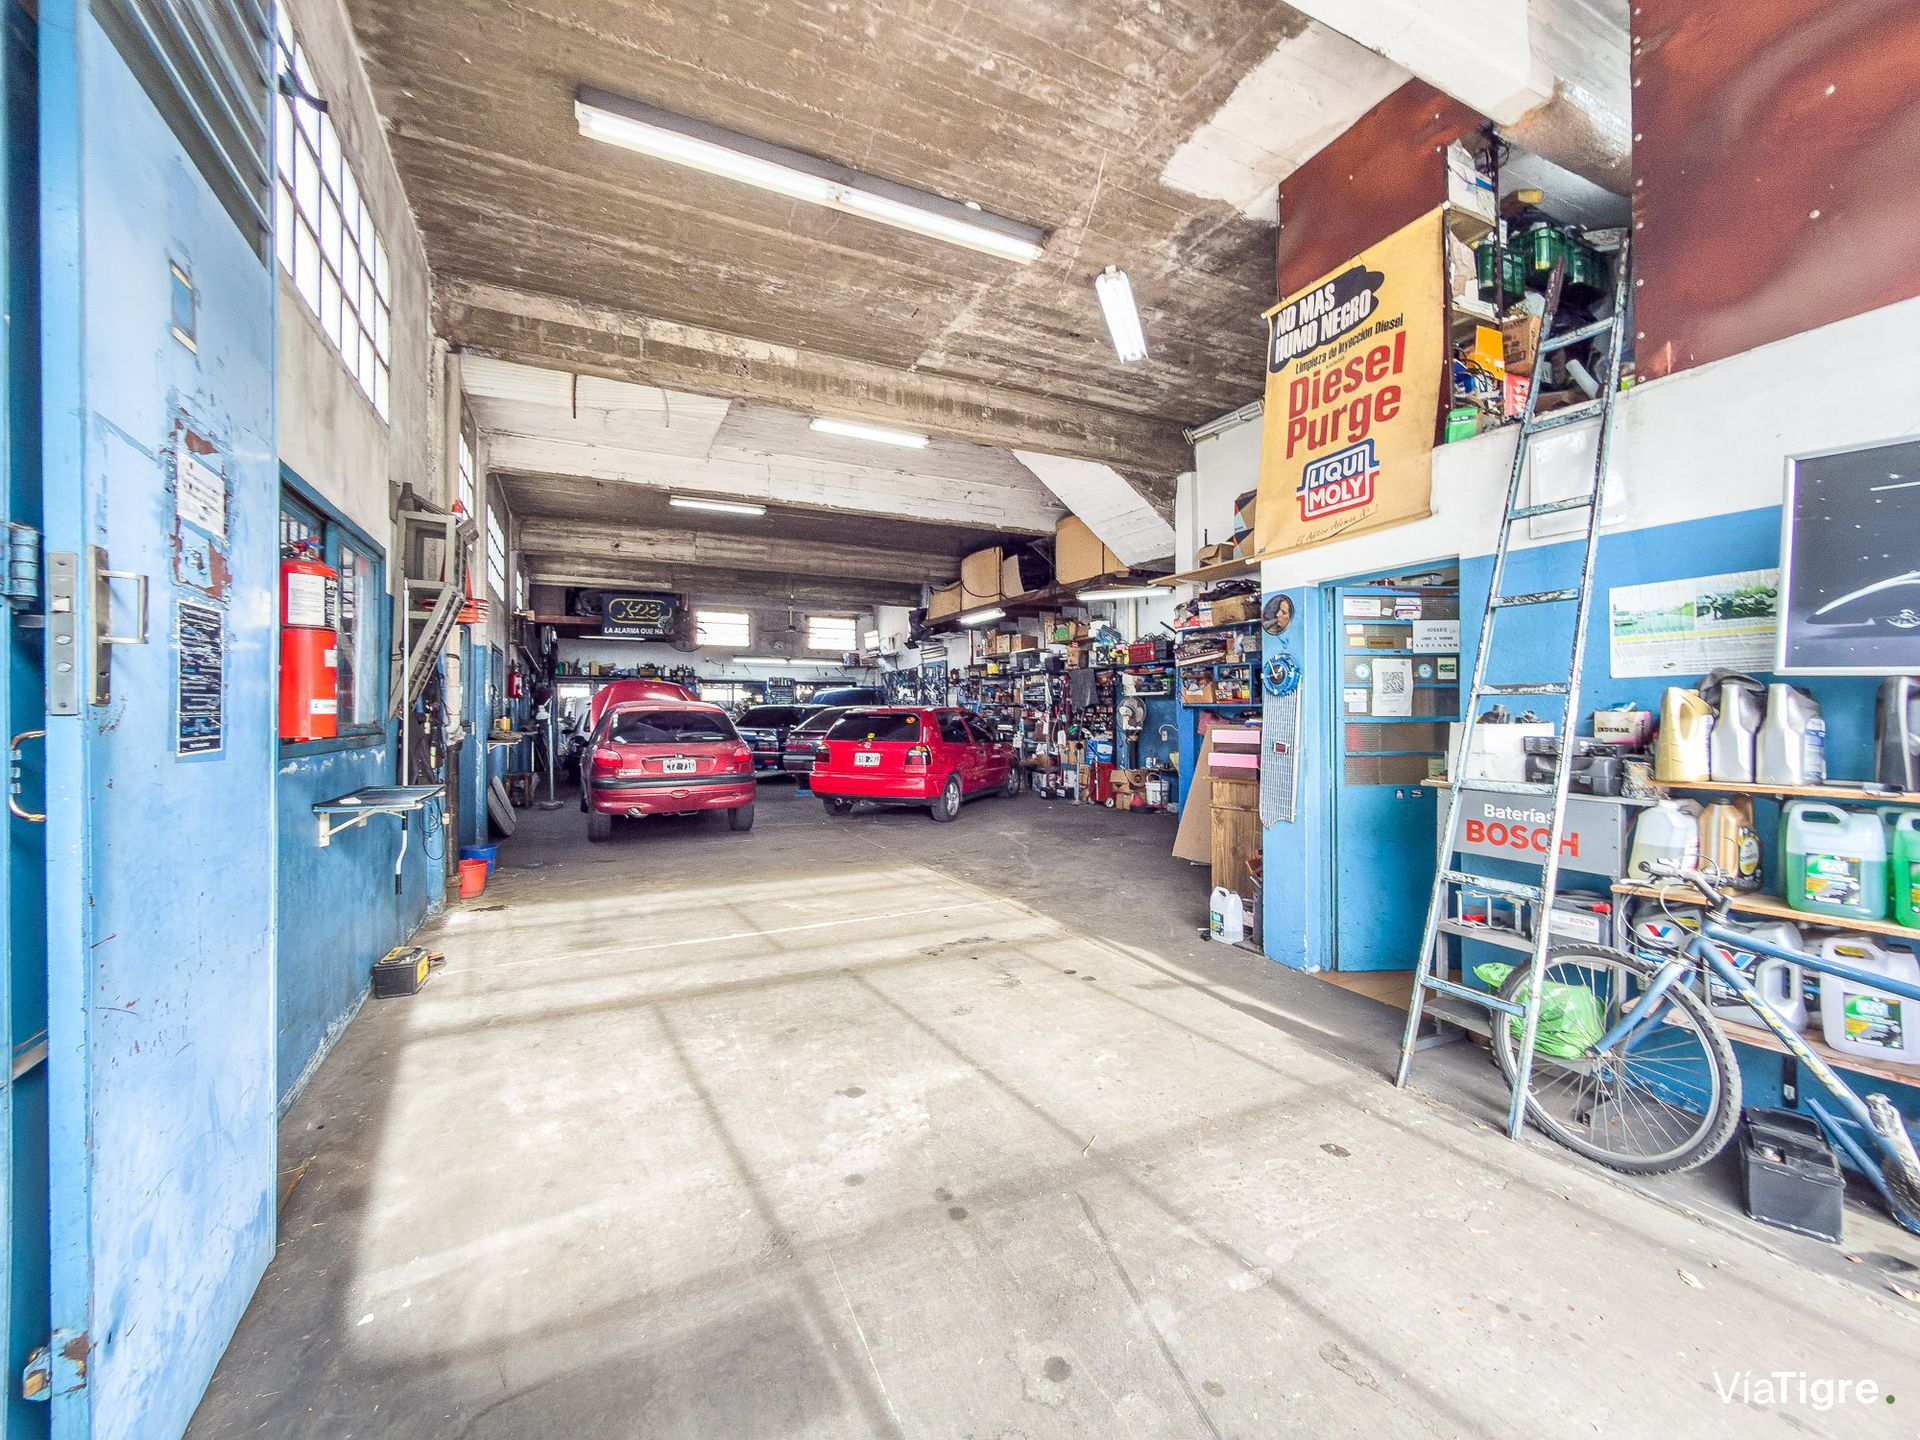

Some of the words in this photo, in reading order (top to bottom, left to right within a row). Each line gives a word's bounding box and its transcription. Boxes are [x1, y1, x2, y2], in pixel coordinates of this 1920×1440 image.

[1274, 320, 1318, 365] HUMO
[1320, 288, 1372, 342] NEGRO
[1276, 304, 1297, 338] NO
[1298, 282, 1336, 326] MAS
[1295, 352, 1327, 375] Limpieza
[1328, 346, 1338, 360] de
[1375, 312, 1404, 335] Diesel
[1288, 330, 1406, 421] Diesel
[1285, 385, 1402, 461] Purge
[1308, 475, 1364, 511] MOLY
[1309, 450, 1364, 489] LIQUI
[616, 600, 661, 619] X-28
[640, 627, 654, 635] QUE
[1466, 818, 1579, 858] BOSCH
